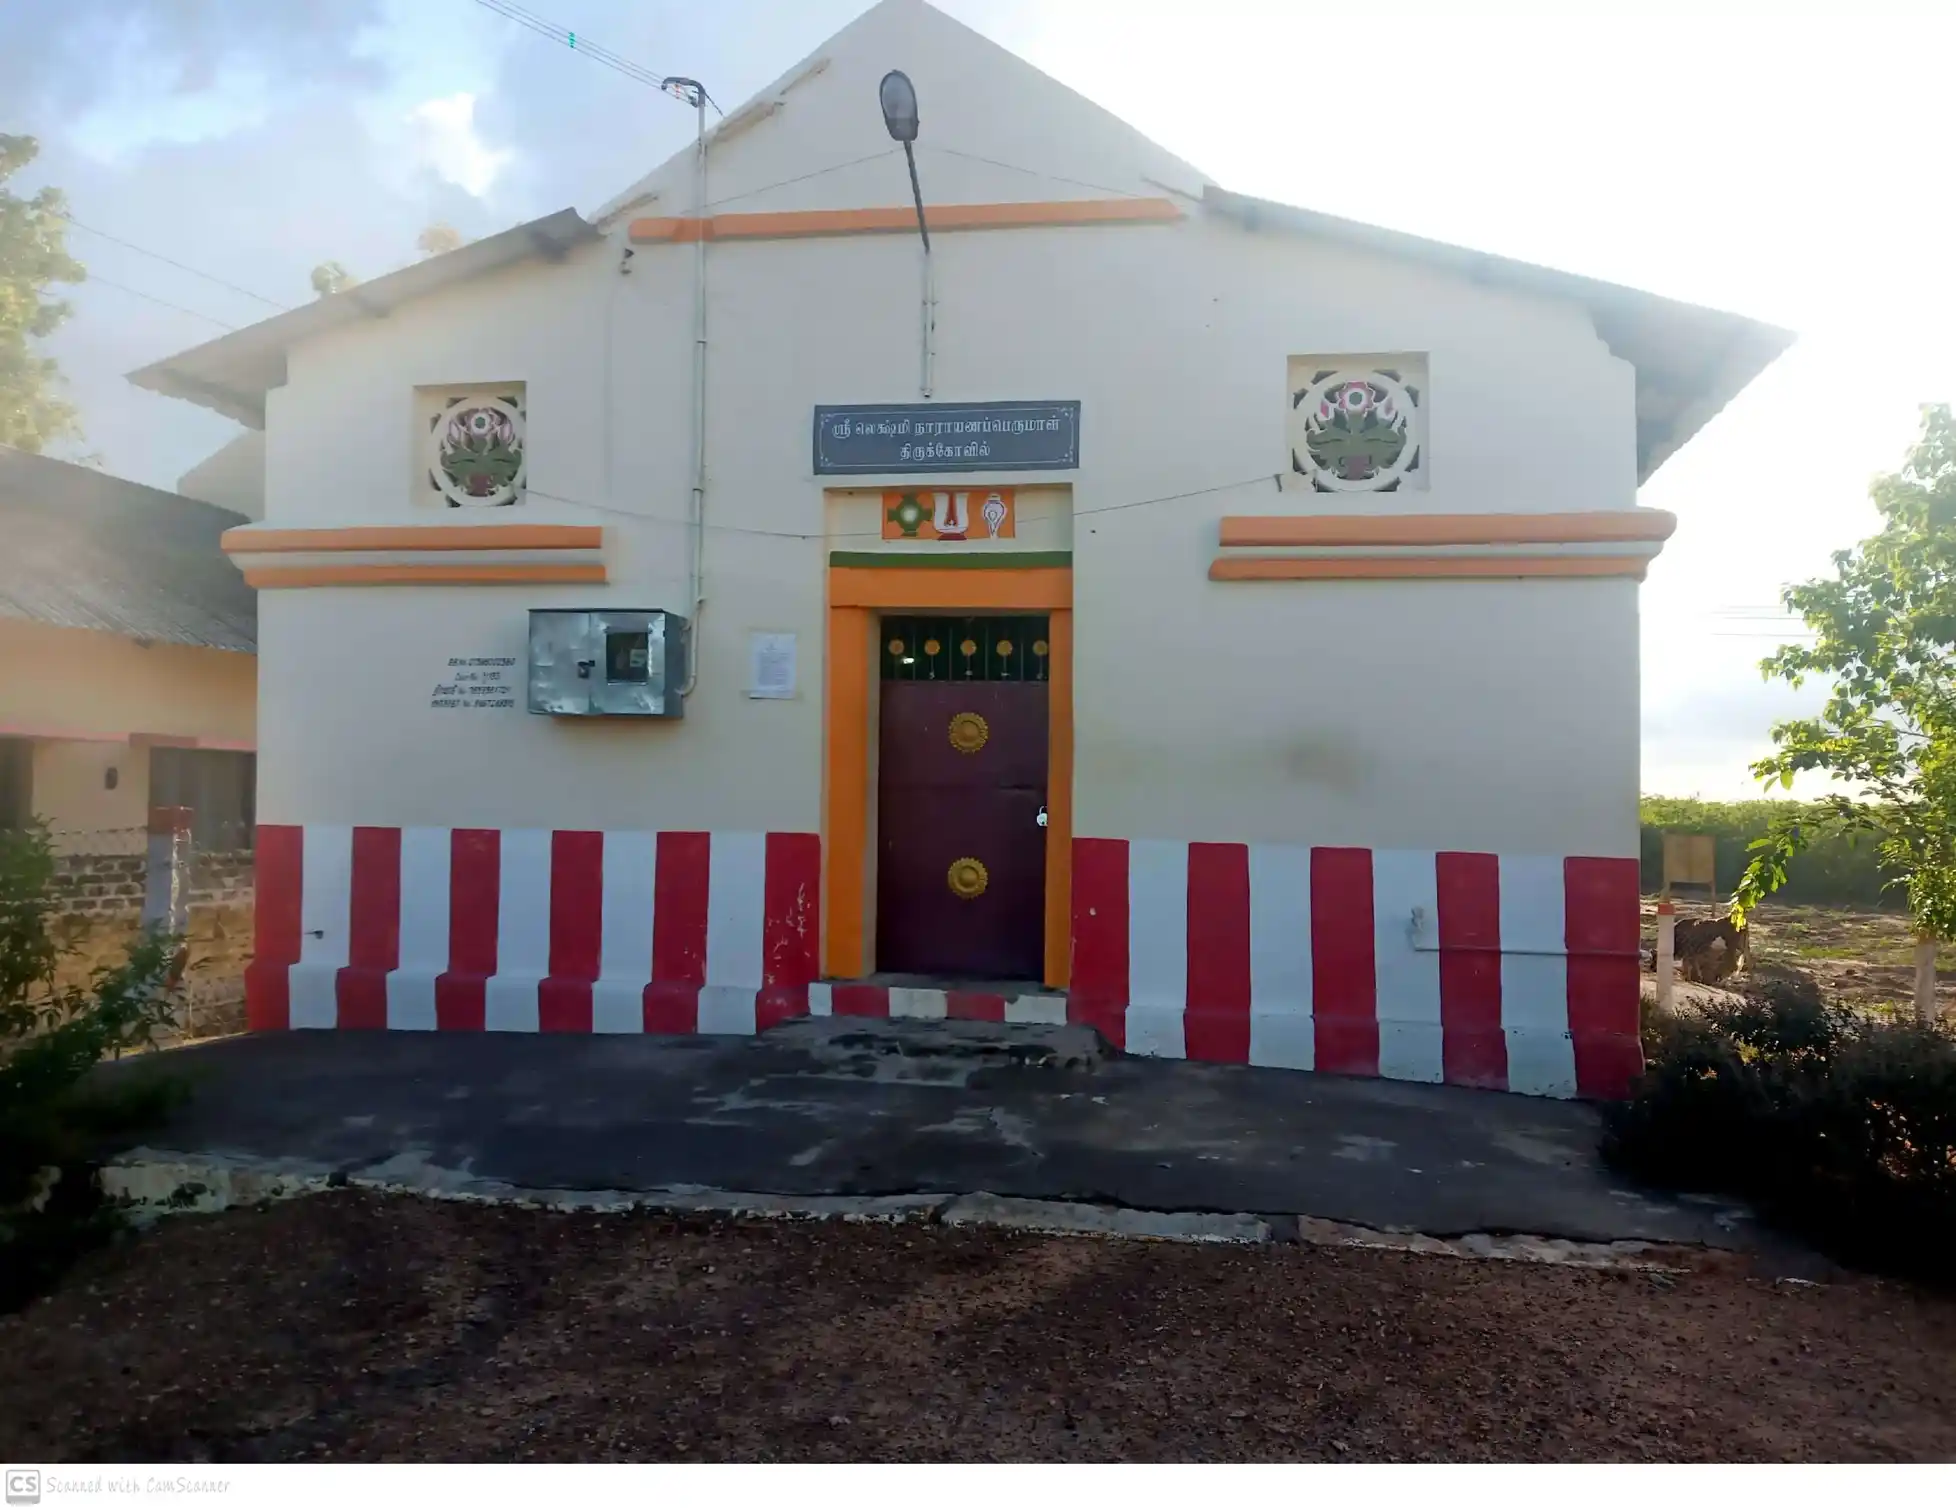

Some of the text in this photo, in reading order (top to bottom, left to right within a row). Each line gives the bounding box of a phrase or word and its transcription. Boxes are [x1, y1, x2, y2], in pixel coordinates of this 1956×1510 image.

[831, 417, 852, 439] ஸ்ரீ
[914, 414, 1062, 437] நாராயணப்பெருமாள்
[899, 440, 991, 461] திருக்கோவில்
